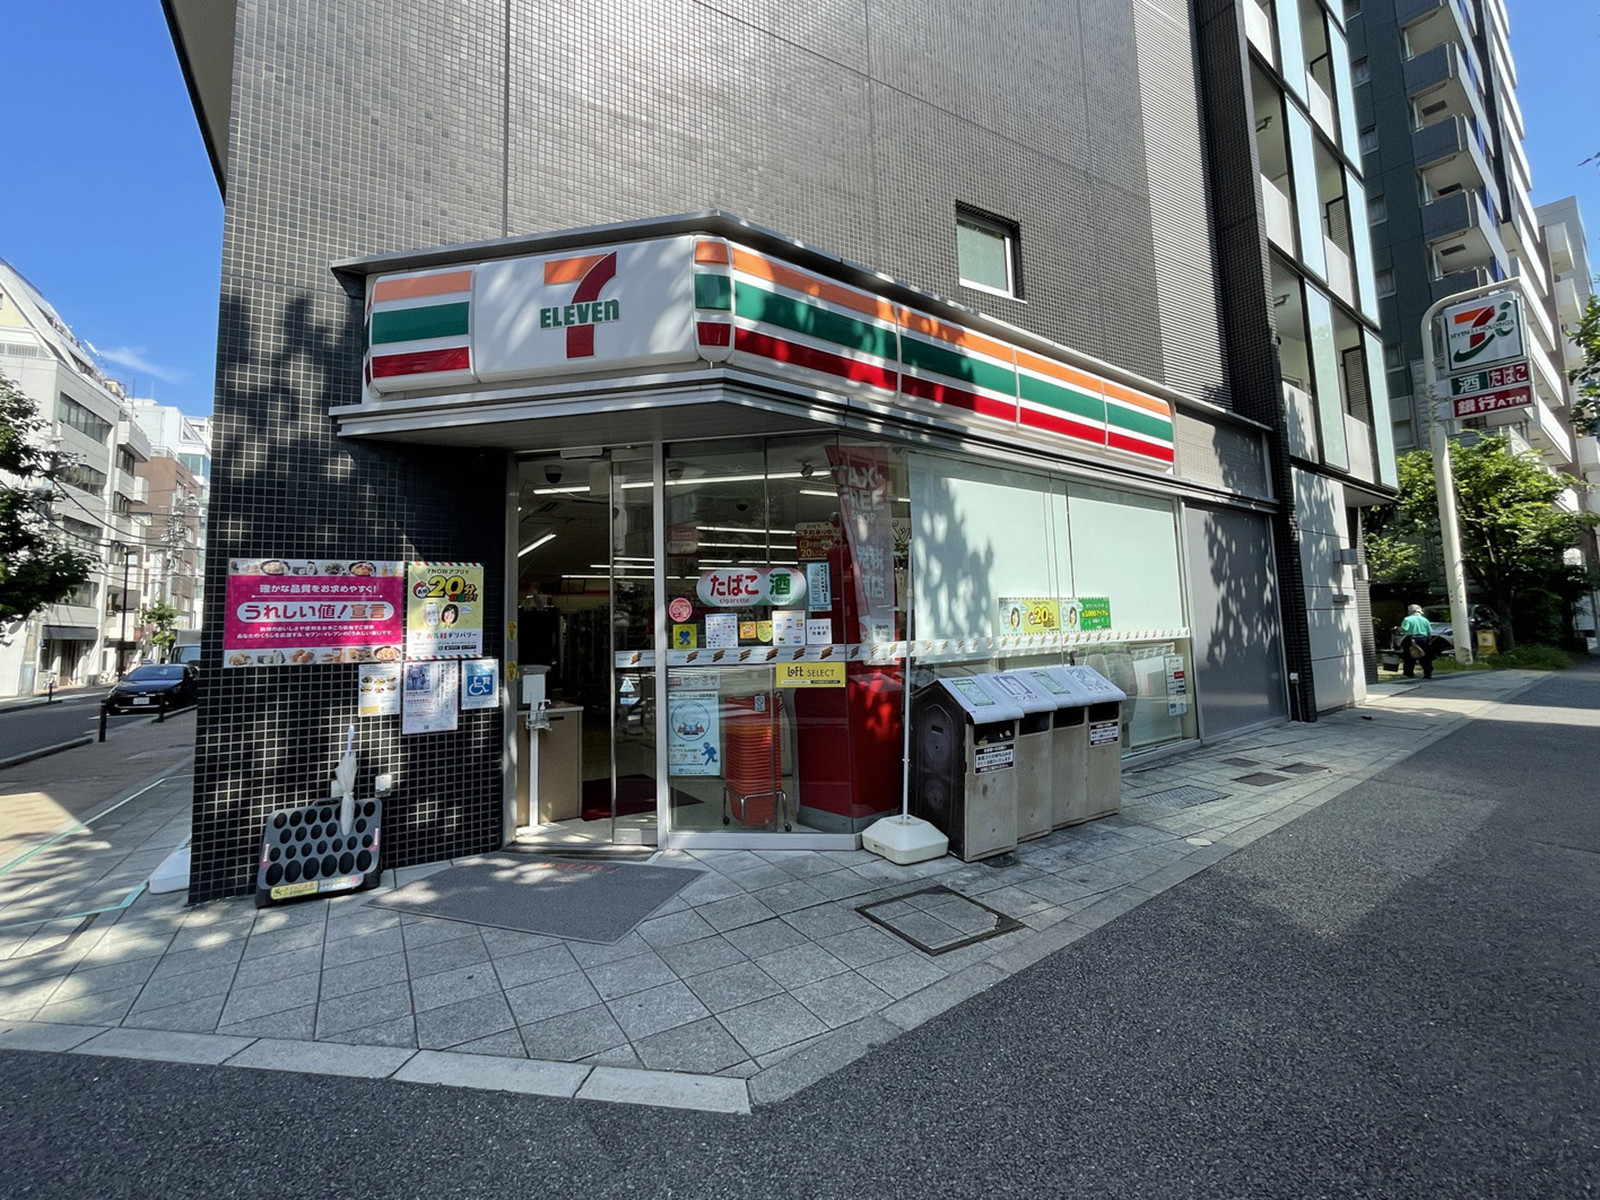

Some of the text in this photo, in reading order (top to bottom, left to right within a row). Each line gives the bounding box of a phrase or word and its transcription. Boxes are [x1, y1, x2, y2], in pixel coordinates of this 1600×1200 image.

[540, 298, 620, 329] ELEVEN
[1459, 374, 1480, 393] 酒
[1490, 365, 1528, 387] たばこ
[710, 574, 759, 596] たばこ
[769, 573, 791, 595] 酒
[244, 603, 387, 620] うれしい値!宣言
[807, 669, 835, 677] SELECT
